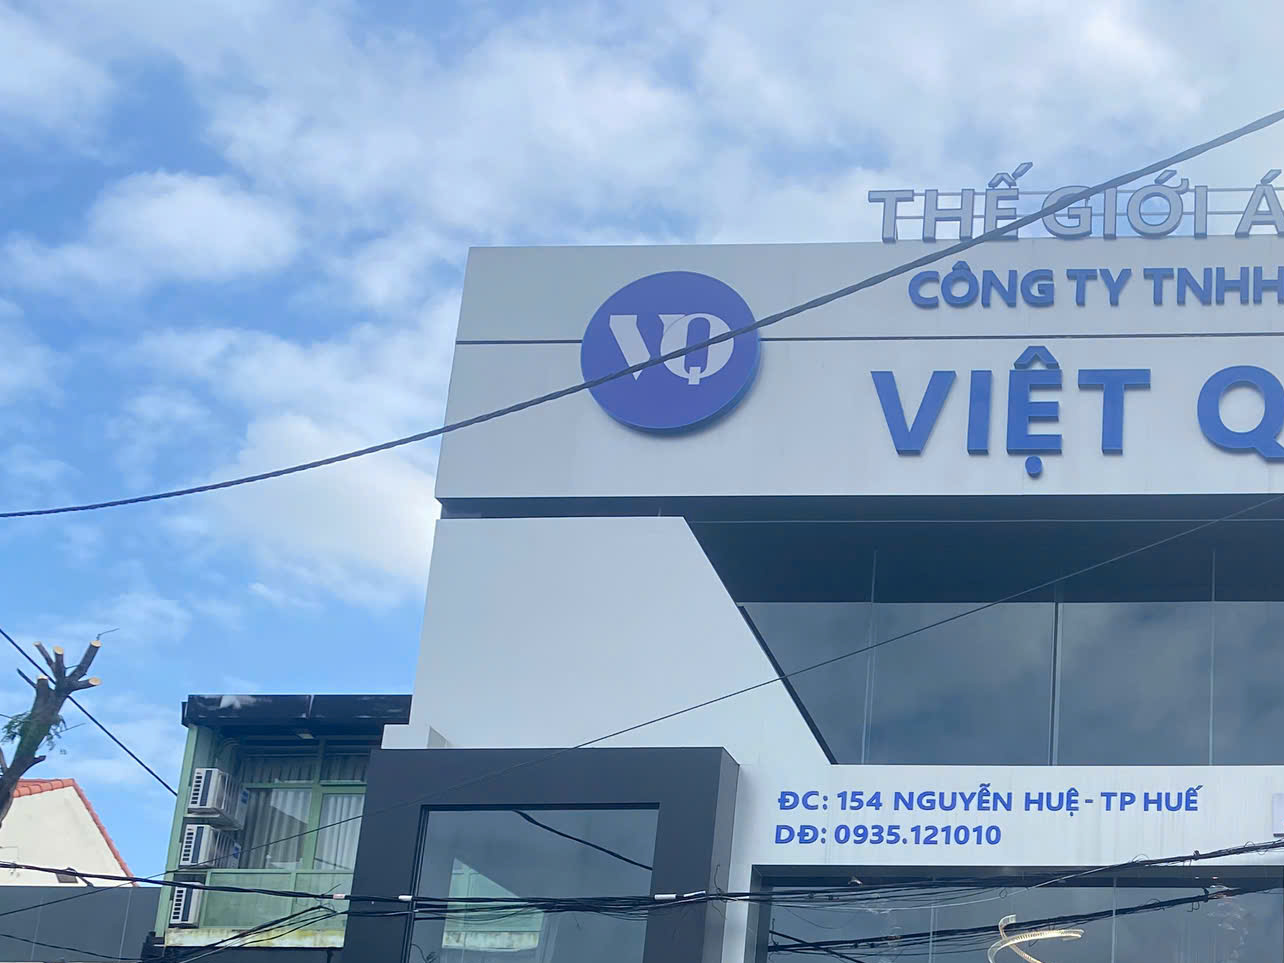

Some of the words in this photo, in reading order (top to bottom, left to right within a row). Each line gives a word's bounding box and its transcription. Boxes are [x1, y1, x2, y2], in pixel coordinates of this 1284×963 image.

[868, 162, 1033, 242] THẾ
[1042, 168, 1208, 240] GIỚI
[908, 260, 1055, 308] CÔNG
[1067, 268, 1133, 307] TY
[870, 345, 1150, 479] VIỆT
[778, 790, 829, 812] ĐC:
[836, 790, 883, 811] 154
[893, 783, 1013, 812] NGUYỄN
[1143, 784, 1204, 812] HUẾ
[774, 824, 827, 845] DĐ:
[834, 824, 1001, 846] 0935.121010
